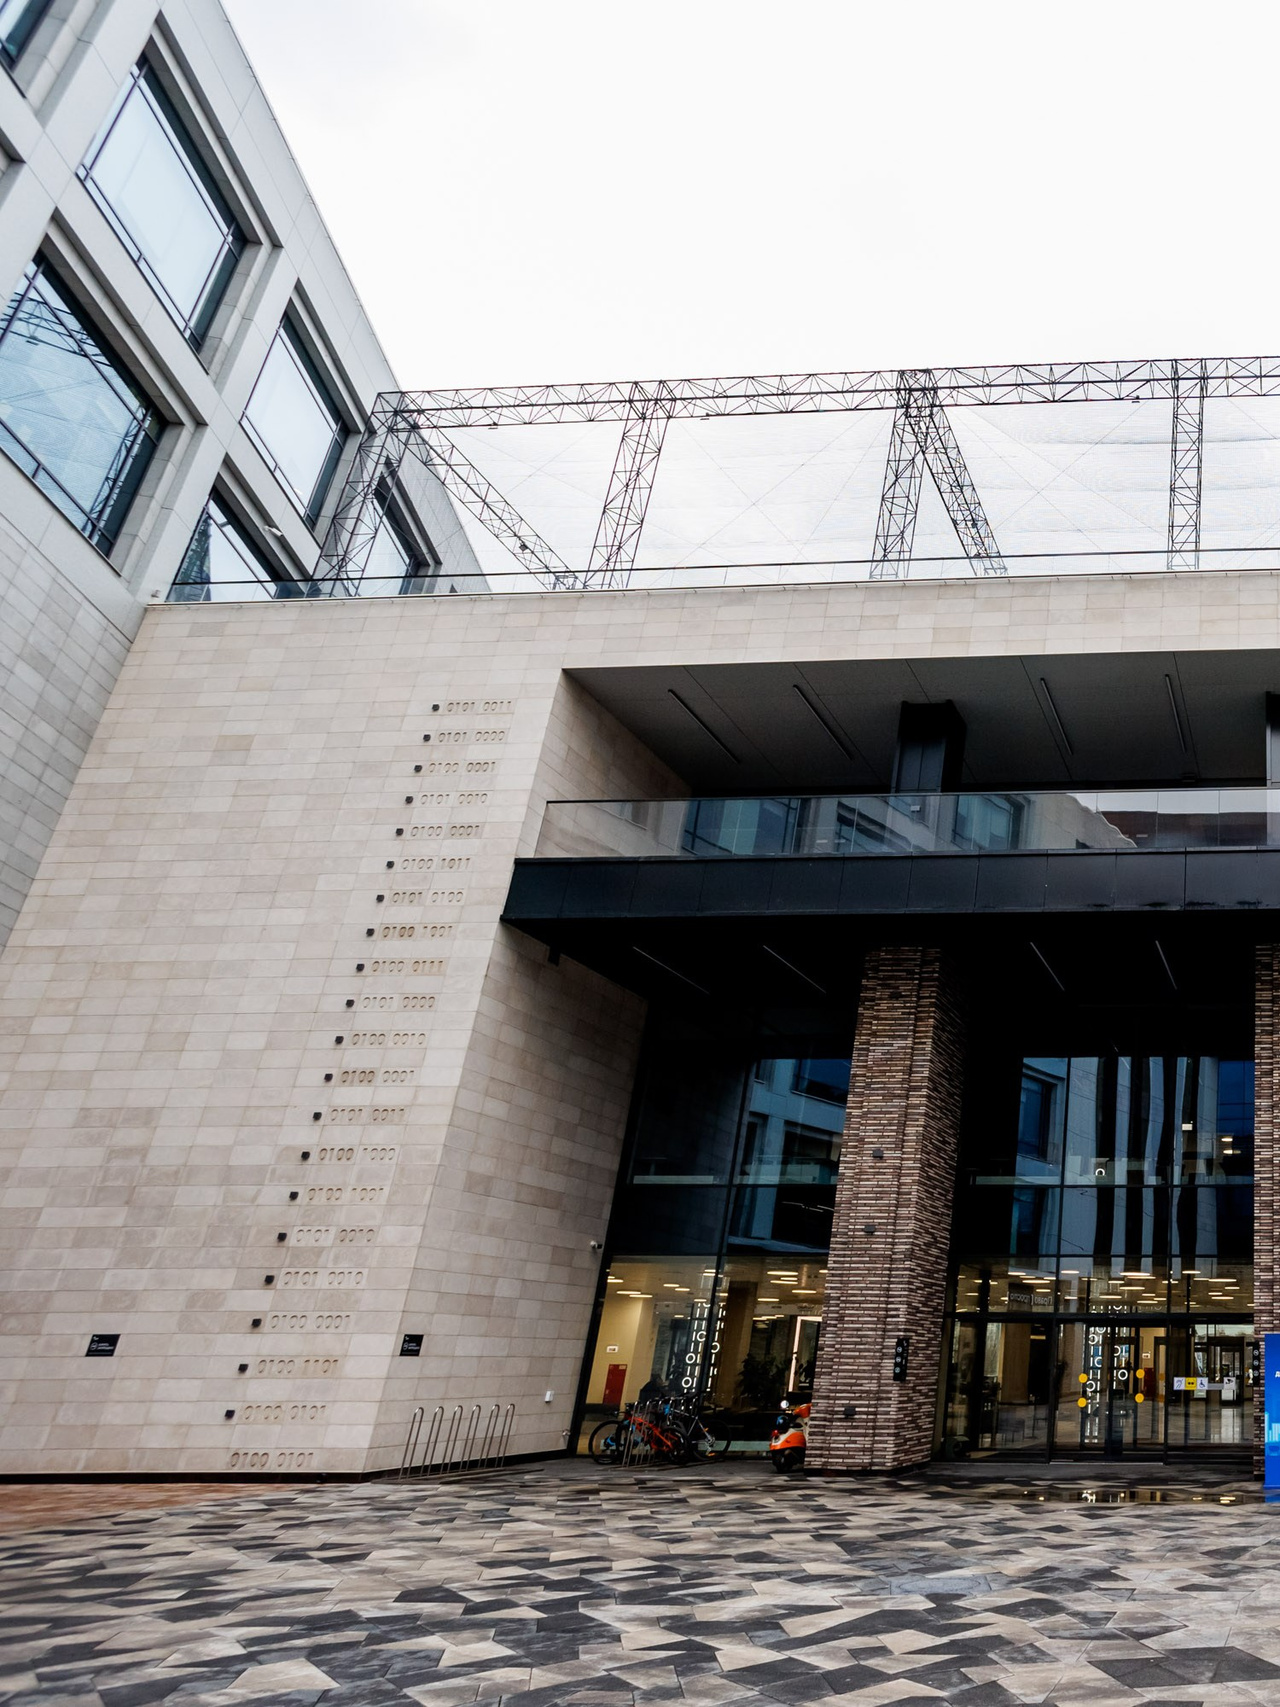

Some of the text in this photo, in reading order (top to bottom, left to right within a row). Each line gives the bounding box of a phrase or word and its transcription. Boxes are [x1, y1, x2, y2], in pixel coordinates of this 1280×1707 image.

[446, 700, 512, 713] 0101 0011
[437, 730, 506, 743] 0101 0000
[428, 761, 496, 774] 0100 0001
[420, 793, 488, 805] 0101 0010
[410, 824, 480, 837] 0100 0001
[400, 857, 471, 870] 0100 1011
[392, 891, 464, 903] 0101 0100
[381, 925, 453, 938] 0100 1001
[371, 960, 444, 973] 0100 0111
[362, 996, 436, 1009] 0101 0000
[351, 1032, 426, 1046] 0100 0010
[340, 1069, 415, 1084] 0100 0001
[330, 1108, 405, 1122] 0101 0011
[318, 1147, 396, 1162] 0100 1000
[307, 1187, 384, 1201] 0100 1001
[295, 1228, 375, 1243] 0101 0010
[283, 1271, 364, 1285] 0101 0010
[271, 1314, 351, 1329] 0100 0001
[257, 1358, 339, 1374] 0100 1101
[243, 1404, 327, 1420] 0100 0101
[229, 1452, 314, 1468] 0100 0101
